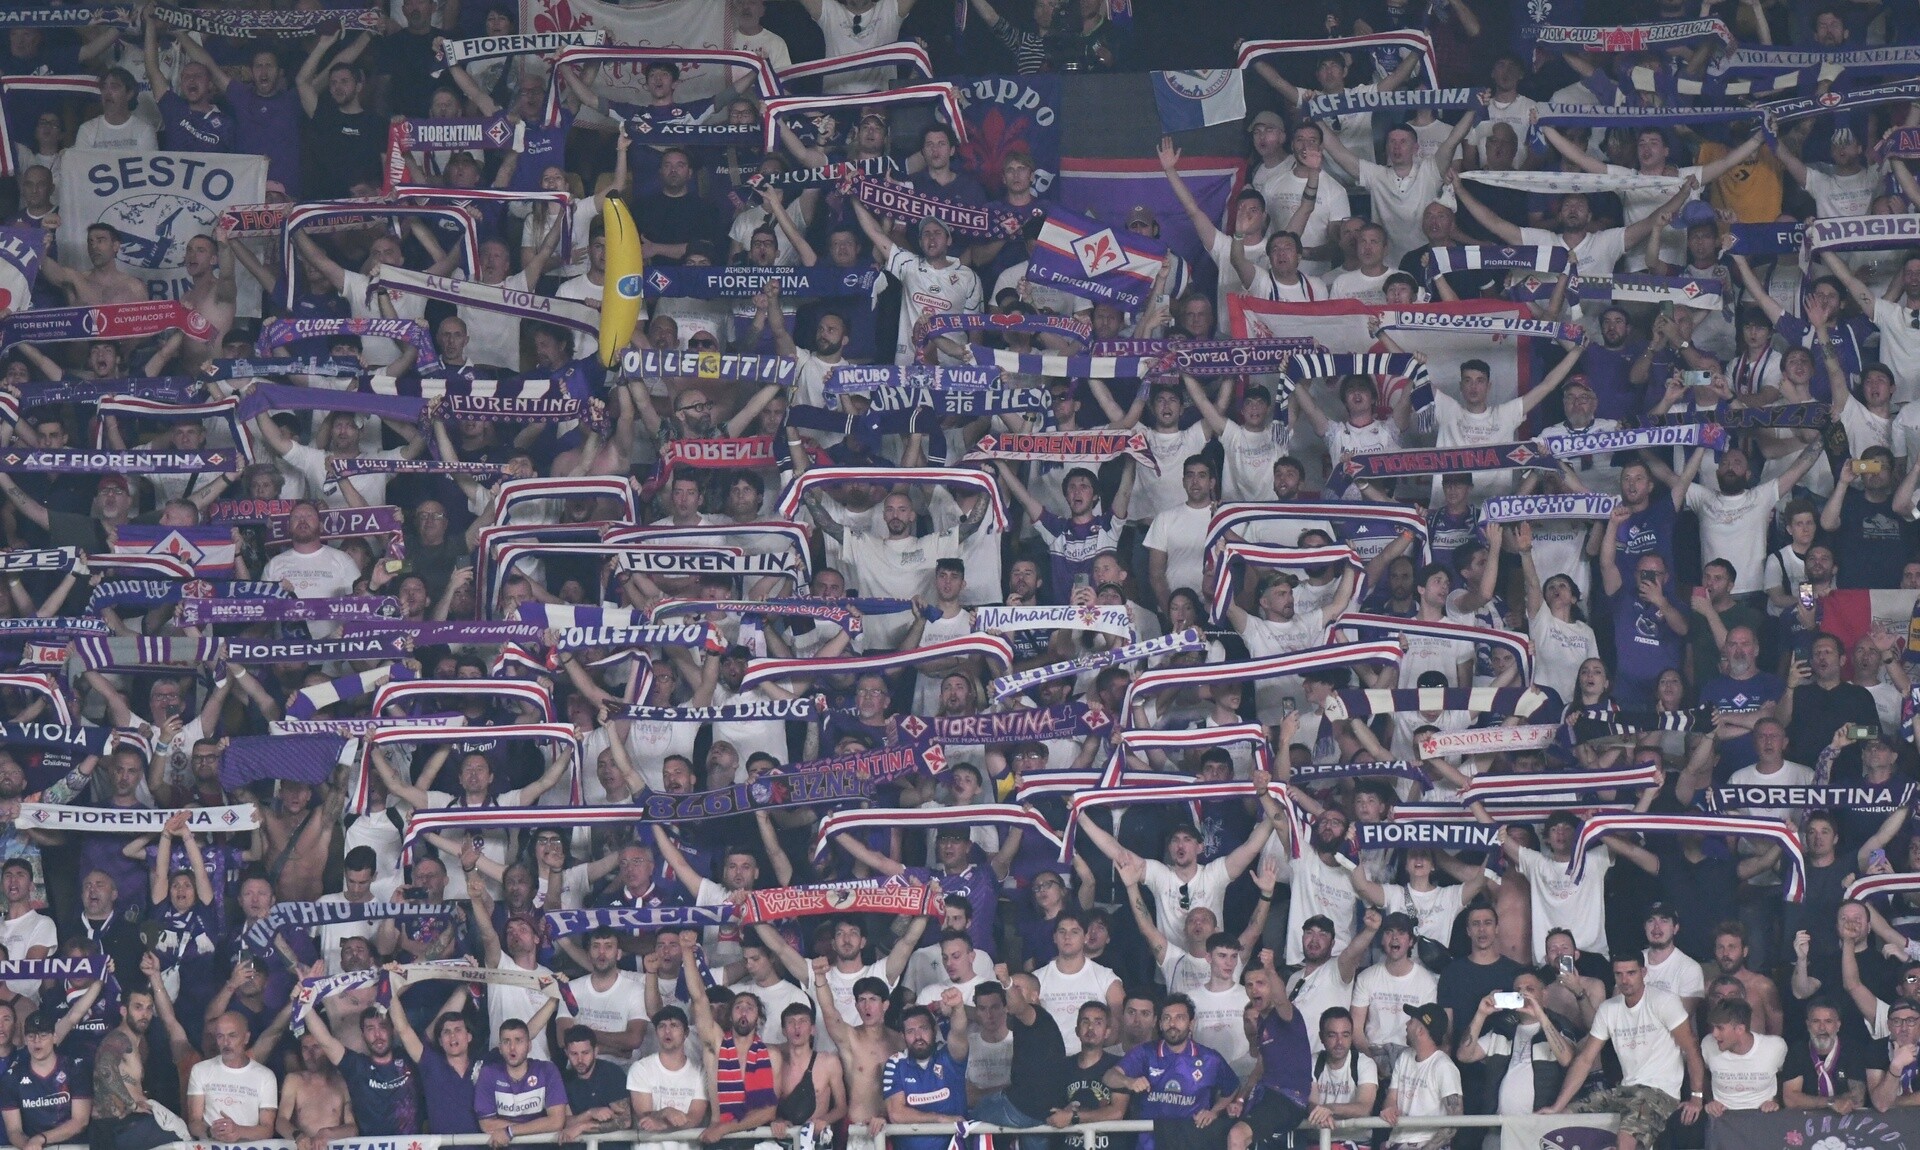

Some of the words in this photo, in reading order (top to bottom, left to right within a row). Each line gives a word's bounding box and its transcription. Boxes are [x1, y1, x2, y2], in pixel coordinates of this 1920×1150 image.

[1540, 28, 1567, 41] VIOLA
[1569, 29, 1599, 42] CLUB
[1649, 20, 1714, 40] BARCELLONA
[463, 33, 585, 55] FIORENTINA
[1737, 52, 1780, 65] VIOLA
[1833, 49, 1920, 64] BRUXELLES
[1309, 94, 1340, 115] ACF
[1345, 87, 1469, 109] FIORENTINA
[1548, 103, 1599, 115] VIOLA
[418, 125, 483, 151] FIORENTINA
[661, 126, 699, 134] ACF
[88, 156, 234, 201] SESTO
[863, 186, 985, 227] FIORENTINA
[1815, 217, 1920, 241] MAGIC
[1484, 259, 1529, 268] FIORENTINA
[1051, 271, 1113, 298] FIORENTINA
[1116, 291, 1139, 306] 1926
[502, 290, 551, 312] VIOLA
[13, 321, 72, 330] FIORENTINA
[114, 314, 162, 323] OLYMPIACOS
[164, 312, 176, 321] FC
[1401, 311, 1493, 329] ORGOGLIO
[1503, 319, 1556, 334] VIOLA
[295, 319, 344, 333] CUORE
[368, 319, 411, 336] VIOLA
[1176, 348, 1230, 367] Forza
[839, 370, 890, 384] INCUBO
[949, 371, 988, 384] VIOLA
[452, 396, 579, 413] FIORENTINA
[1000, 433, 1126, 454] FIORENTINA
[1551, 432, 1637, 453] ORGOGLIO
[1645, 428, 1694, 445] VIOLA
[23, 454, 66, 466] ACF
[71, 453, 206, 466] FIORENTINA
[1370, 450, 1501, 475] FIORENTINA
[1489, 498, 1575, 516] ORGOGLIO
[211, 605, 265, 616] INCUBO
[329, 604, 371, 614] VIOLA
[983, 607, 1078, 630] Malmantile
[229, 640, 383, 659] FIORENTINA
[733, 699, 809, 718] DRUG
[20, 722, 87, 747] VIOLA
[933, 712, 1053, 738] FIORENTINA
[1719, 787, 1893, 805] FIORENTINA
[1364, 824, 1501, 847] FIORENTINA
[857, 888, 922, 900] NEVER
[766, 898, 824, 912] WALK
[856, 897, 921, 911] ALONE
[22, 1093, 67, 1109] Mediacom
[497, 1098, 539, 1114] Mediacom
[909, 1092, 948, 1104] Nintendo
[1146, 1092, 1197, 1107] SAMMONTANA
